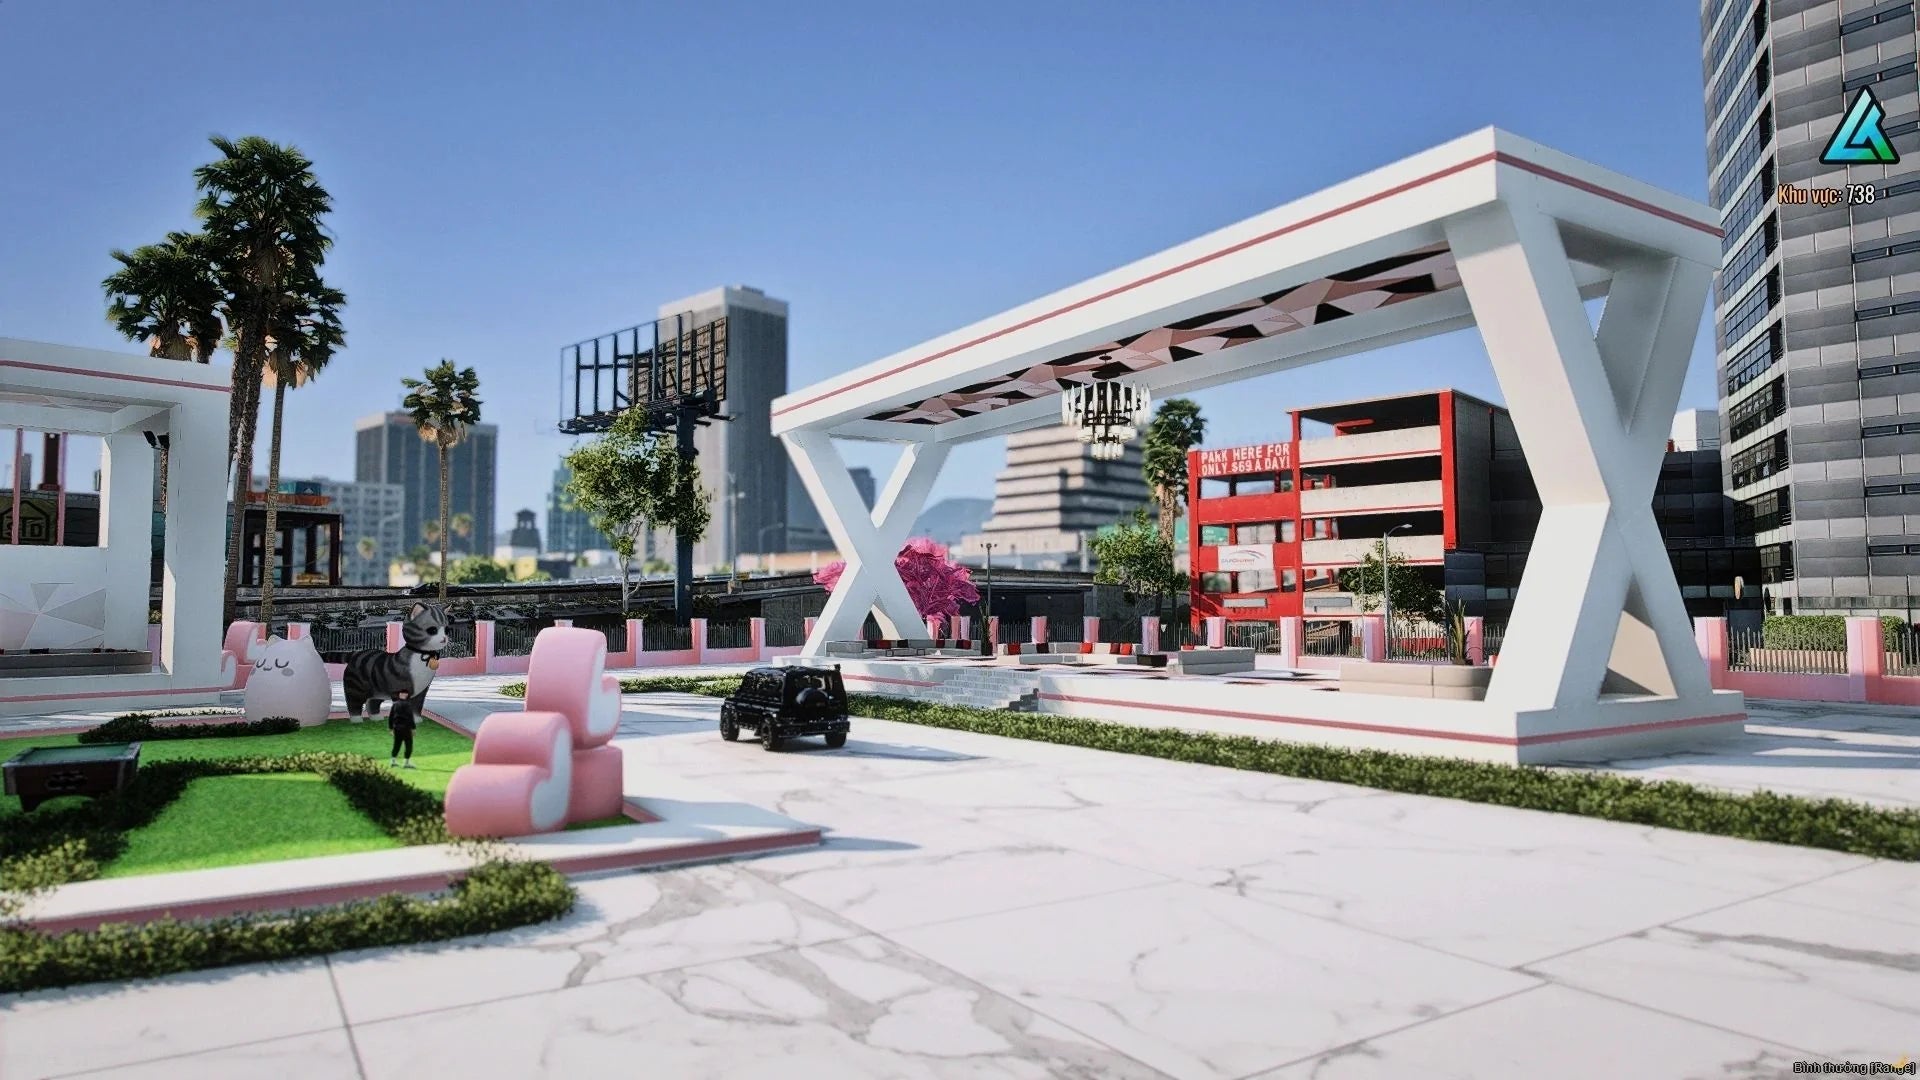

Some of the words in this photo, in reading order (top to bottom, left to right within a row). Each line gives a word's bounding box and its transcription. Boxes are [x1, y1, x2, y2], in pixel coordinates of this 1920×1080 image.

[1232, 446, 1262, 461] HERE
[1266, 443, 1290, 458] FOR
[1201, 462, 1228, 476] ONLY
[1231, 459, 1252, 473] $69
[1254, 459, 1262, 471] A
[1264, 455, 1290, 470] DAY!
